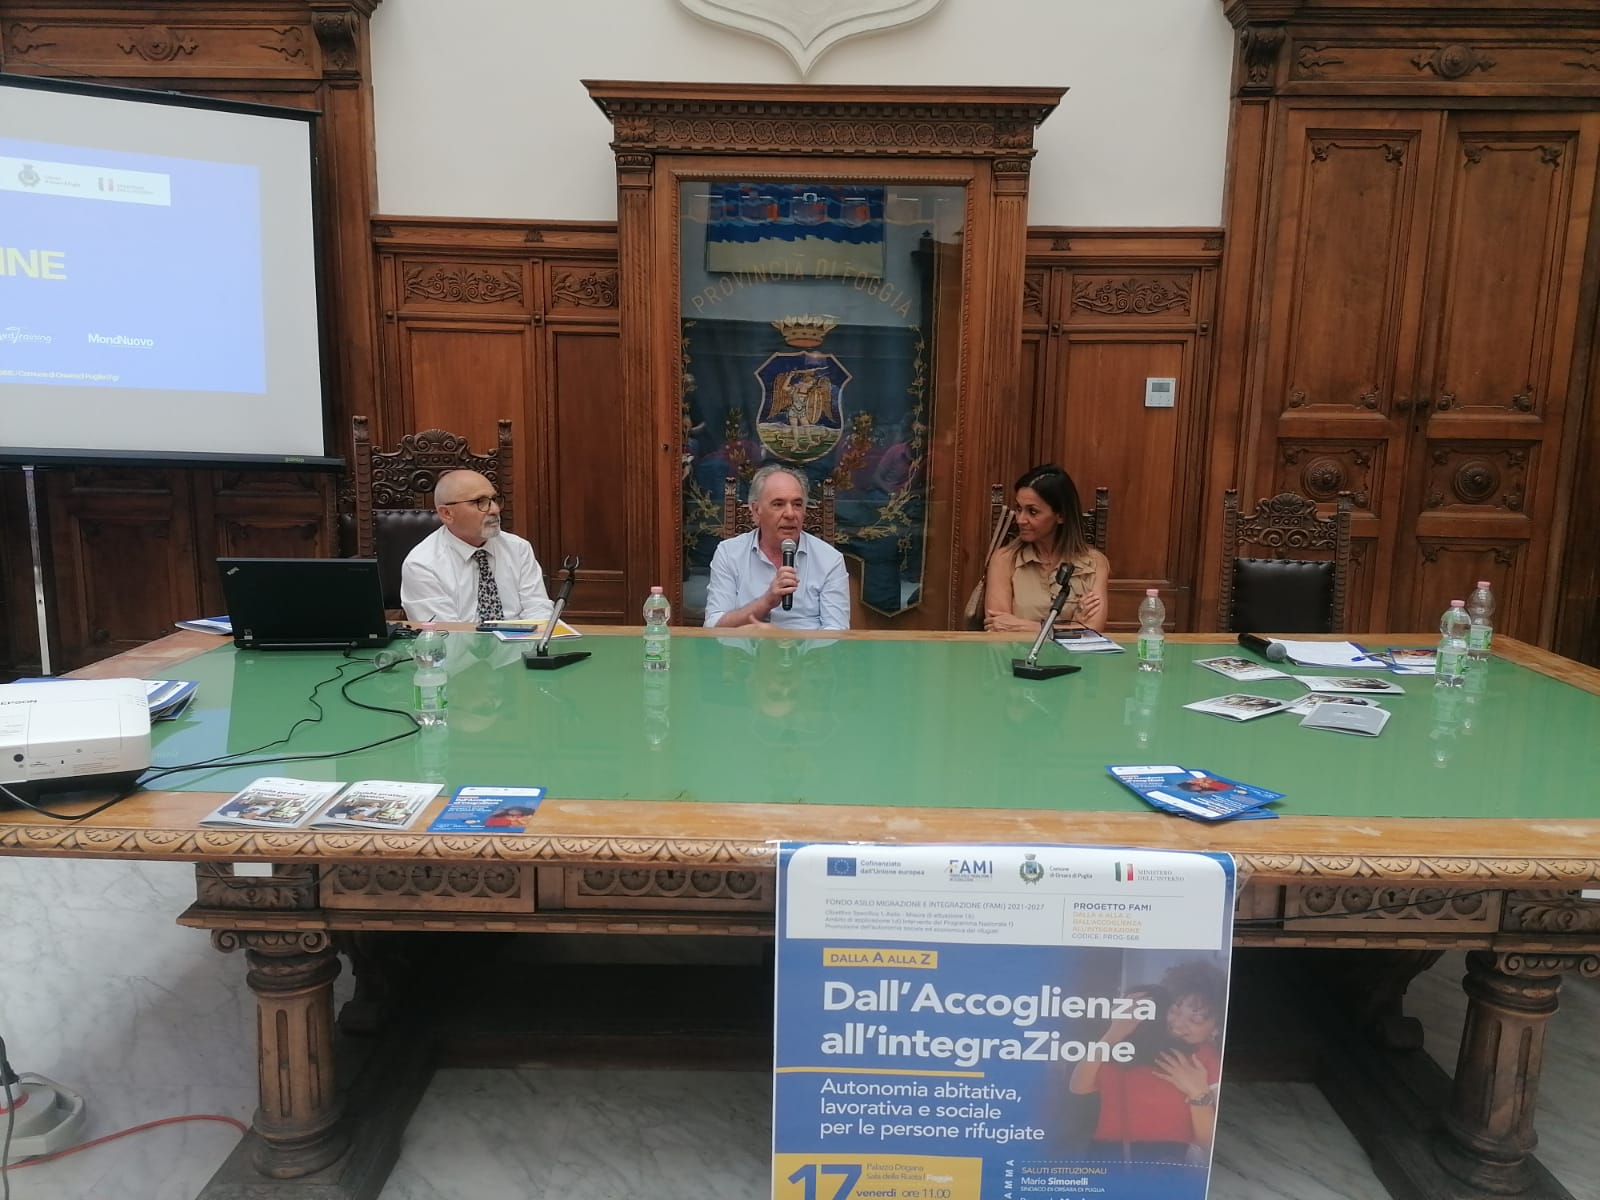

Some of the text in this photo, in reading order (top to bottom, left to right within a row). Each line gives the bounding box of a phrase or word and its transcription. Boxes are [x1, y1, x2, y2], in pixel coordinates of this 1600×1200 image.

[691, 258, 912, 319] PROVINCIA DI FOGGIA
[88, 333, 154, 347] MondNuovo
[948, 859, 993, 874] FAMI
[825, 898, 852, 906] FONDO
[929, 901, 981, 909] INTEGRAZIONE
[982, 902, 1007, 910] (FAMI)
[1007, 903, 1045, 911] 2021-2027
[1073, 902, 1152, 911] PROGETTO FAMI
[830, 951, 931, 965] DALLA A ALLA Z
[823, 979, 1157, 1026] Dall'Accoglienza
[821, 1023, 1136, 1067] all'integraZione
[820, 1078, 1022, 1103] Autonomia abitativa,
[820, 1097, 1002, 1120] lavorativa e sociale
[820, 1118, 1045, 1144] per le persone rifugiate
[866, 1162, 924, 1172] Palazzo Dogana
[1050, 1167, 1107, 1175] ISTITUZIONALI
[787, 1163, 863, 1200] 17
[1020, 1177, 1088, 1186] Mario Simonelli
[901, 1190, 920, 1198] ore
[922, 1188, 951, 1199] 11.00
